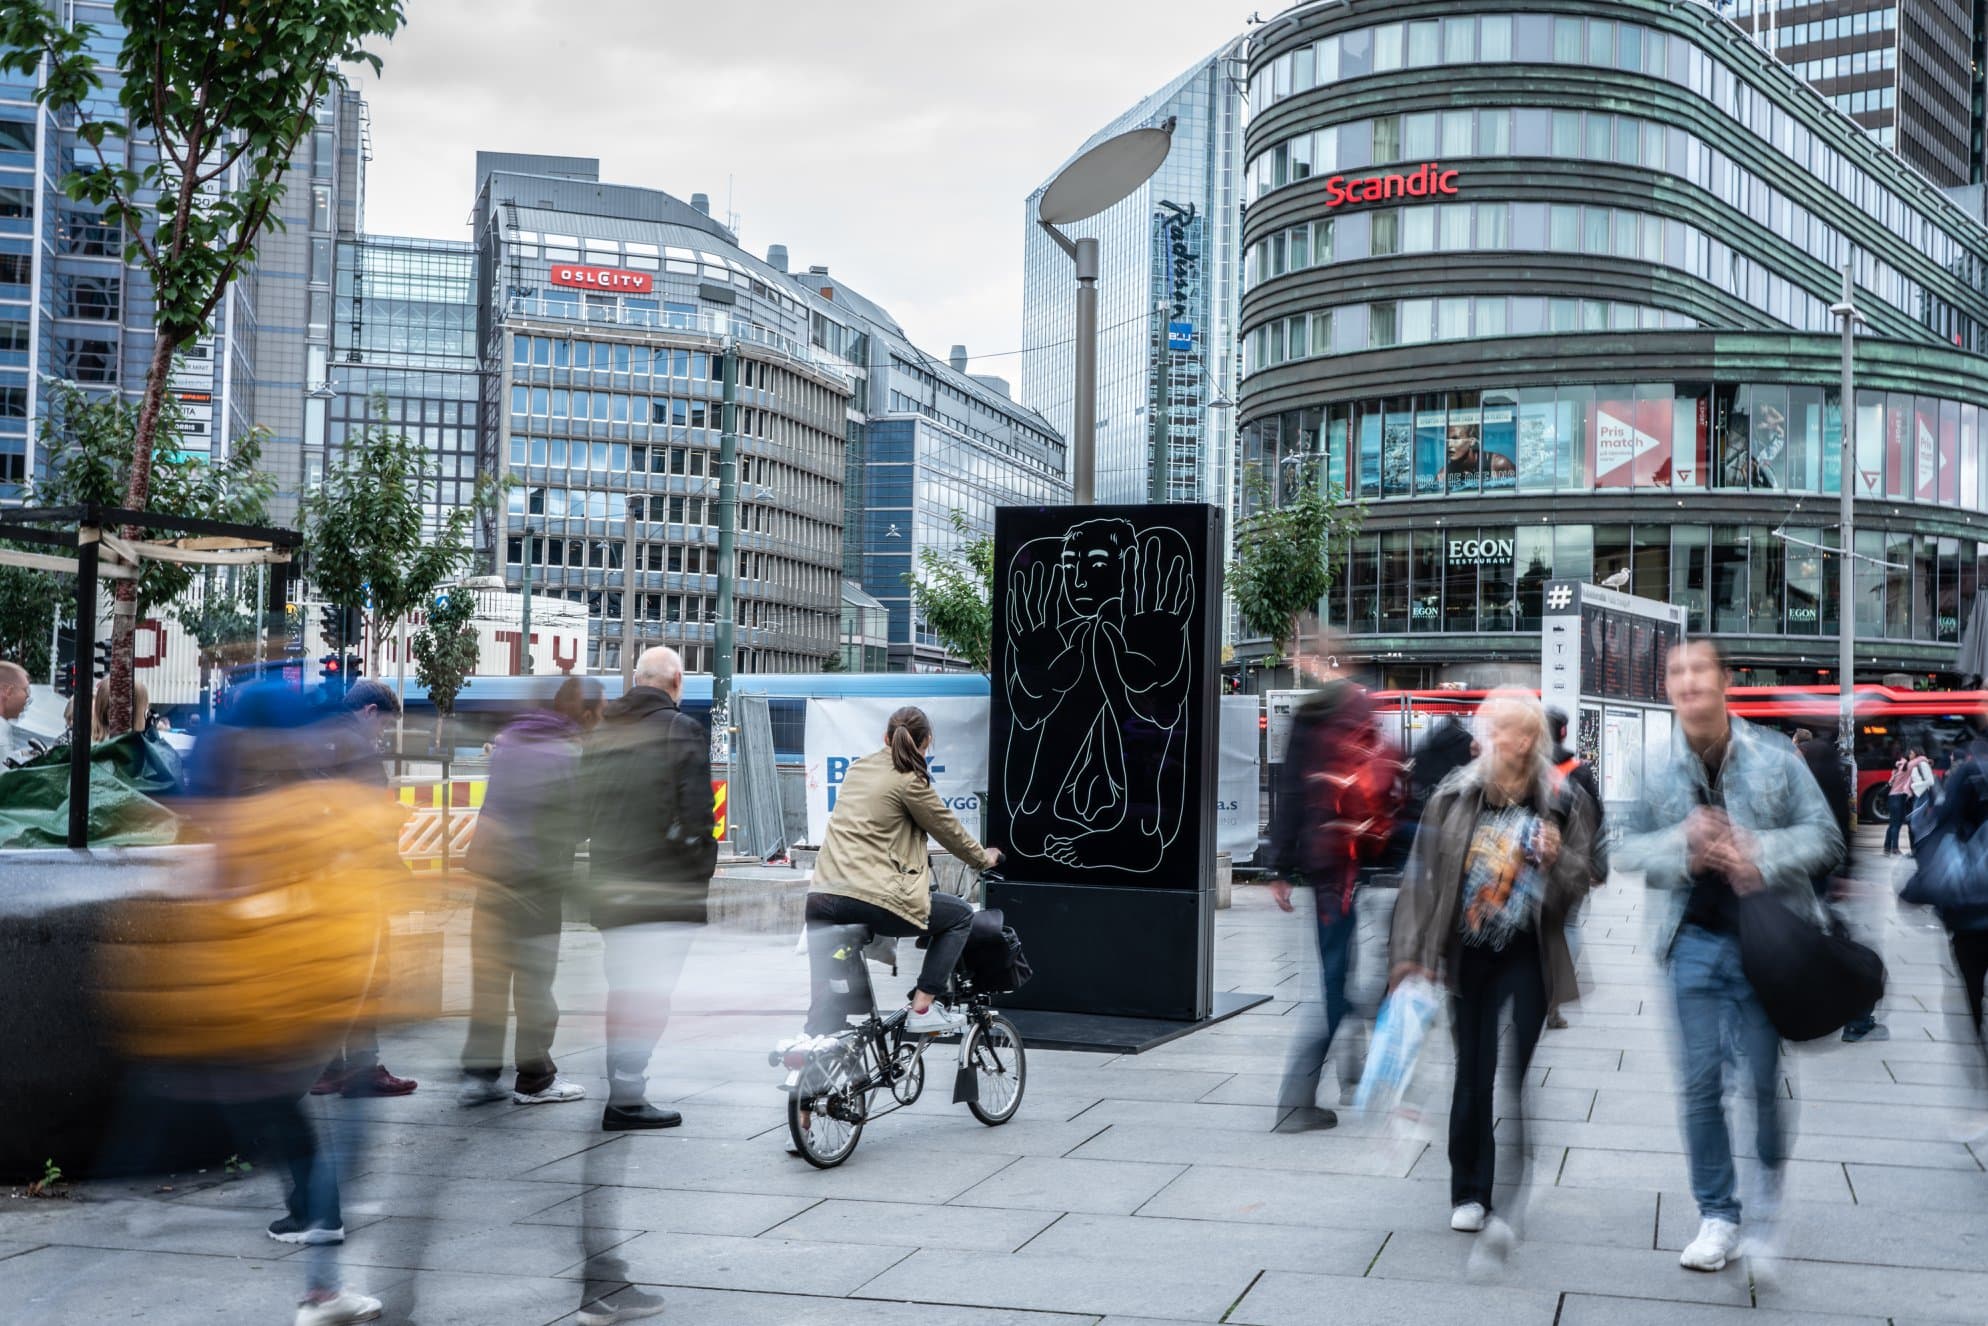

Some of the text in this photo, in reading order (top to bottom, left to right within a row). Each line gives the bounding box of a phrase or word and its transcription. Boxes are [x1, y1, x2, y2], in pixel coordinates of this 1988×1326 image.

[1325, 163, 1459, 207] Scandic
[1158, 200, 1200, 320] Radisson
[1600, 425, 1625, 438] Pris
[1600, 437, 1644, 448] match
[1449, 539, 1514, 558] EGON
[1449, 557, 1512, 565] RESTAURANT
[1412, 607, 1439, 616] EGON
[1789, 608, 1816, 617] EGON
[941, 797, 978, 810] YGG
